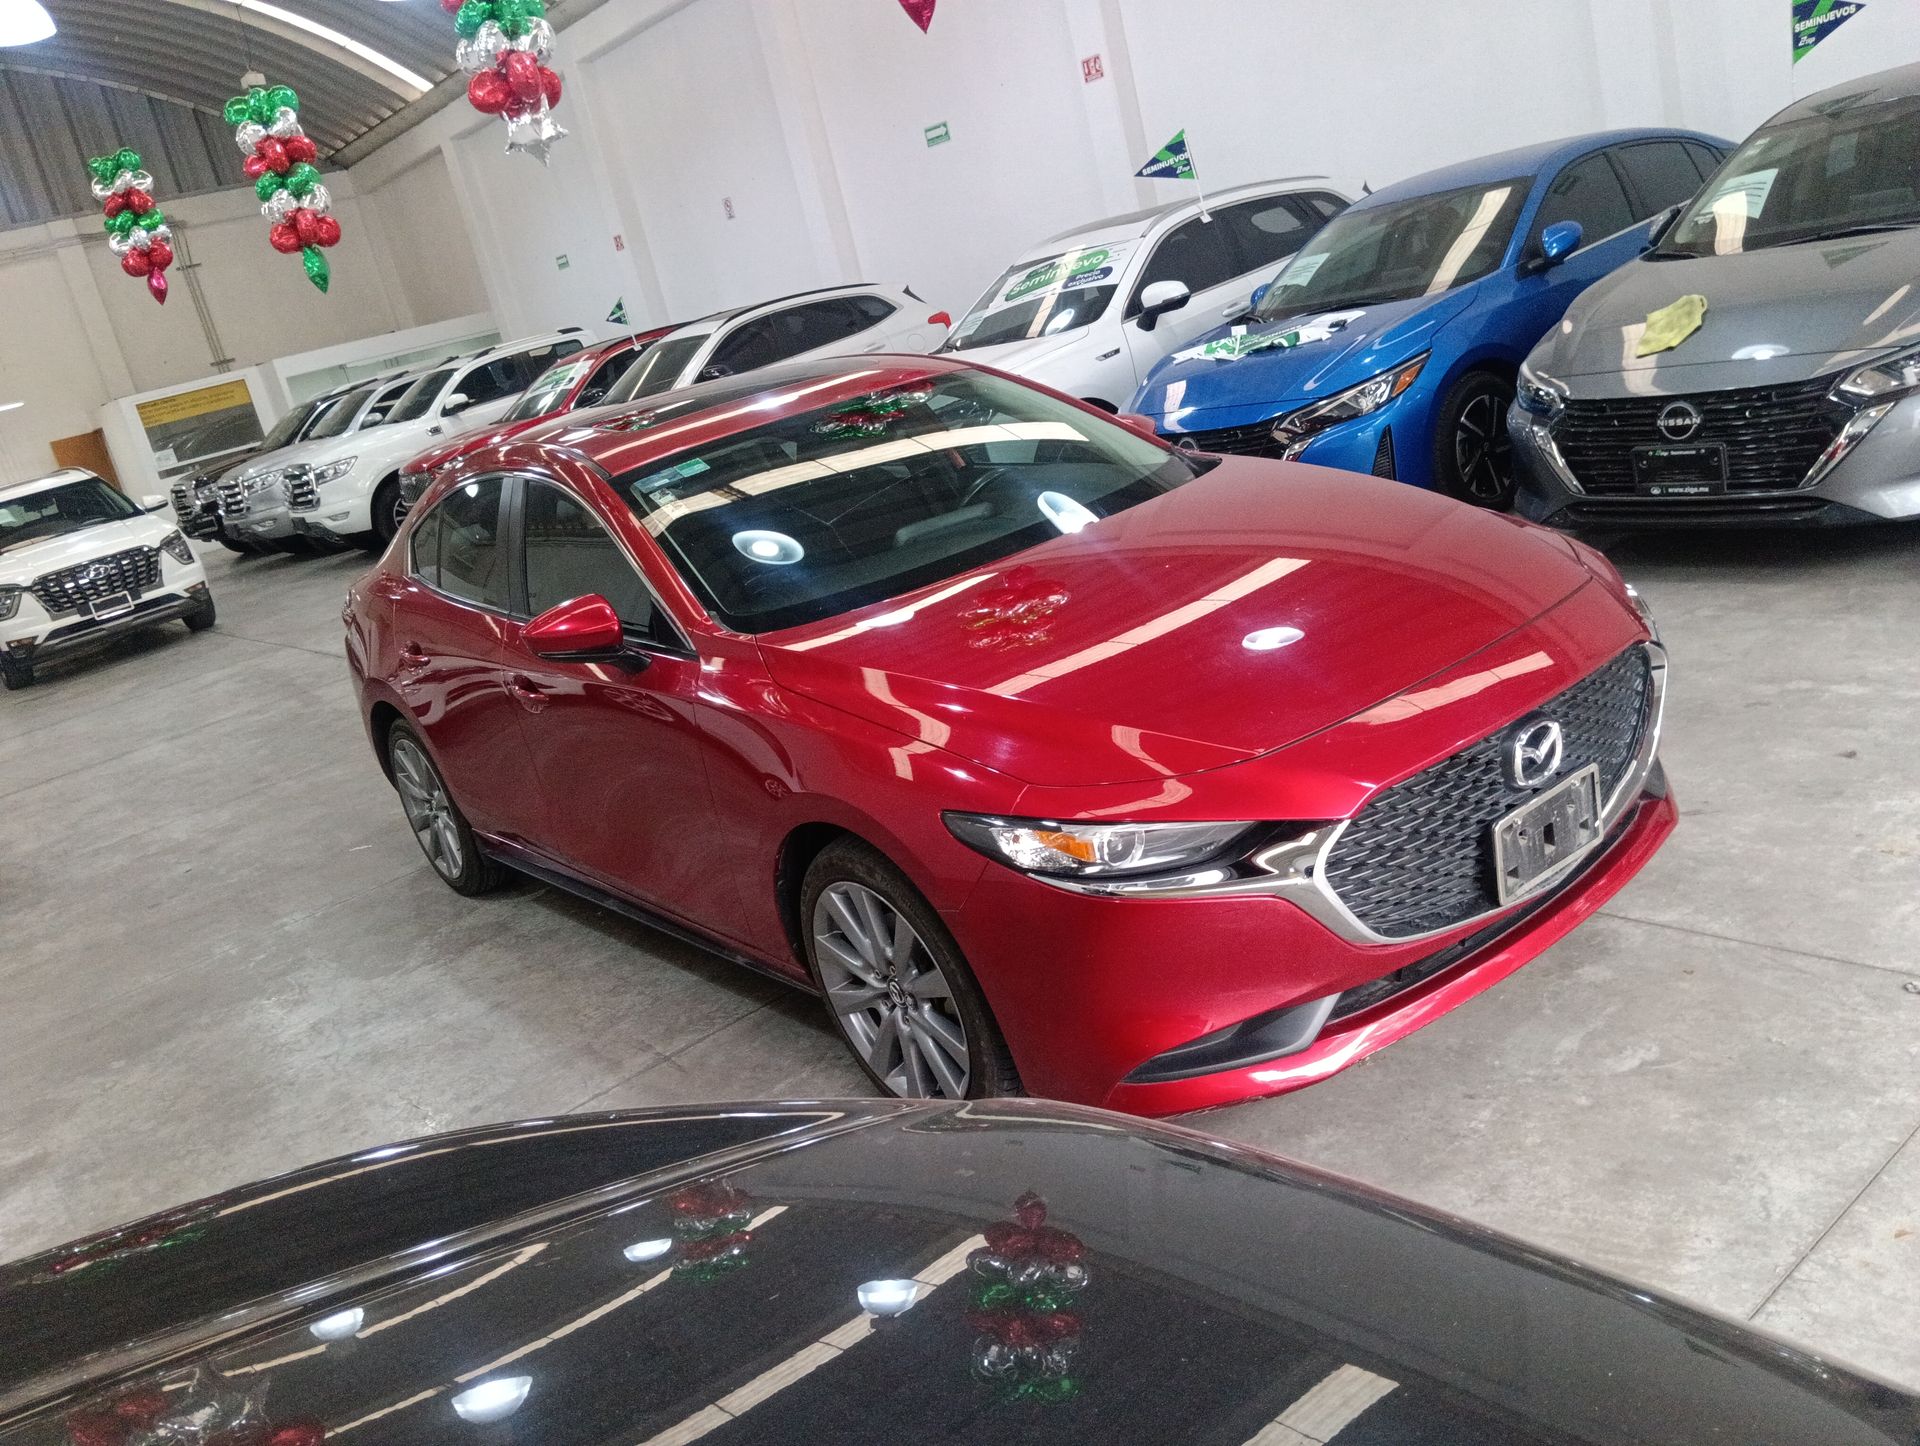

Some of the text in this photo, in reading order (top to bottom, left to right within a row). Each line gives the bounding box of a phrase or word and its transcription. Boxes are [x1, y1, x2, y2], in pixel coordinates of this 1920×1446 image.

[1794, 4, 1856, 33] SEMINUEVOS
[1142, 152, 1189, 175] SEMINUEVOS
[1657, 416, 1700, 426] NISSAN
